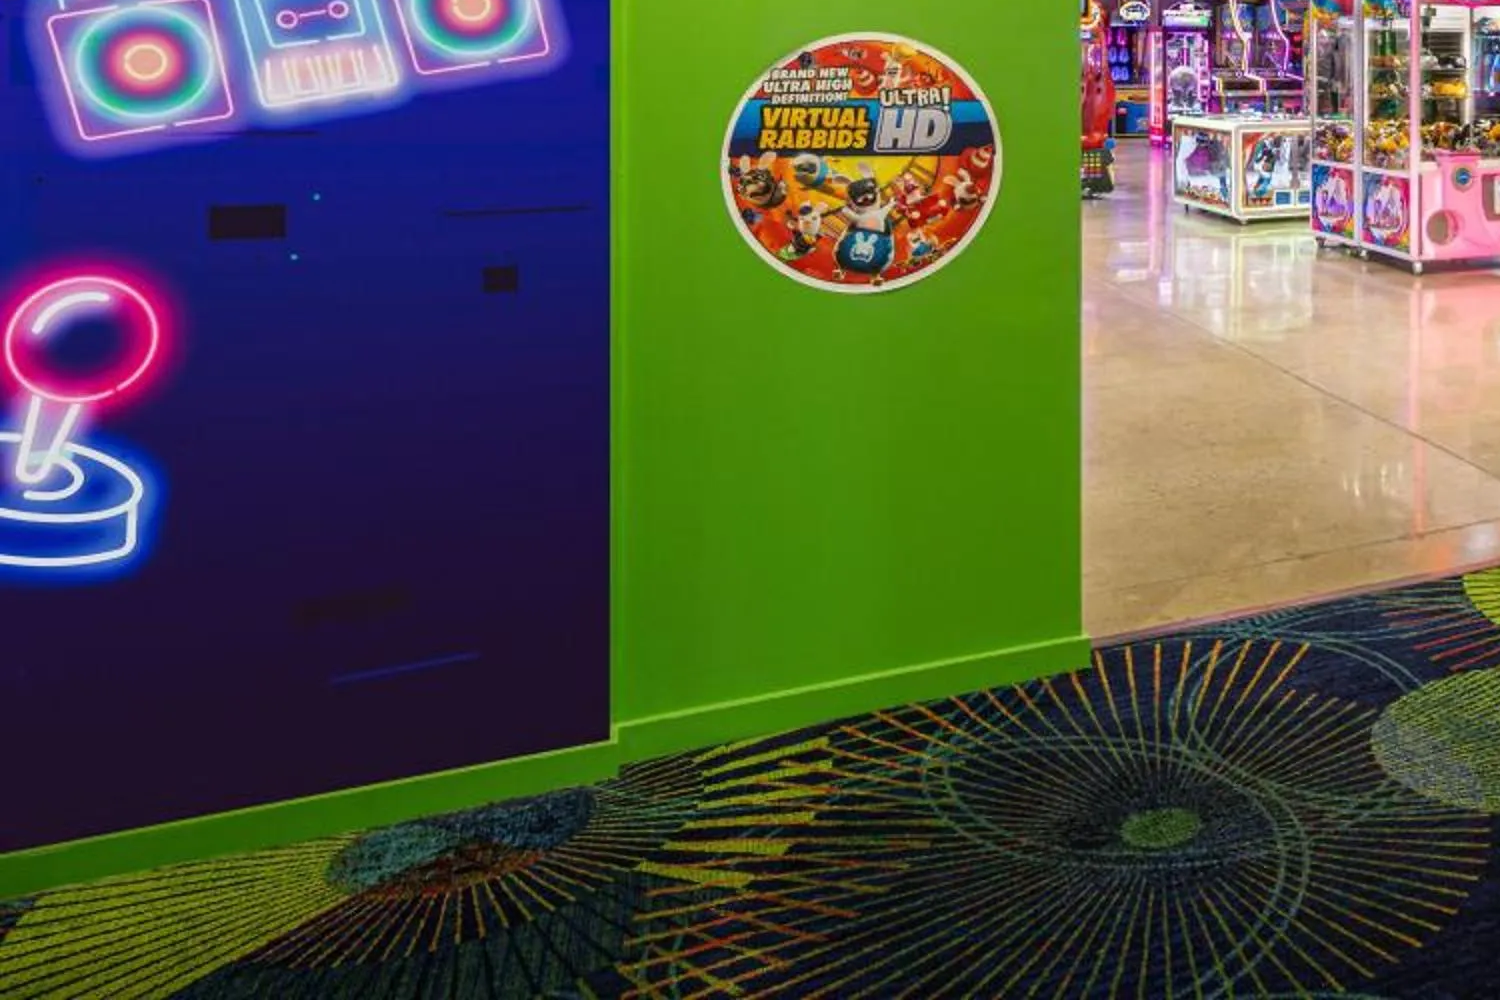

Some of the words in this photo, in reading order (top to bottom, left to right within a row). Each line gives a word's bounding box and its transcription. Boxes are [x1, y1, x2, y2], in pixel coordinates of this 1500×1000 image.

[819, 67, 849, 78] NEW
[763, 80, 811, 92] ULTRA
[815, 79, 853, 91] HIGH
[879, 87, 951, 112] ULTRA!
[762, 107, 870, 129] VIRTUAL
[759, 129, 868, 149] RABBIDS
[876, 107, 952, 151] HD
